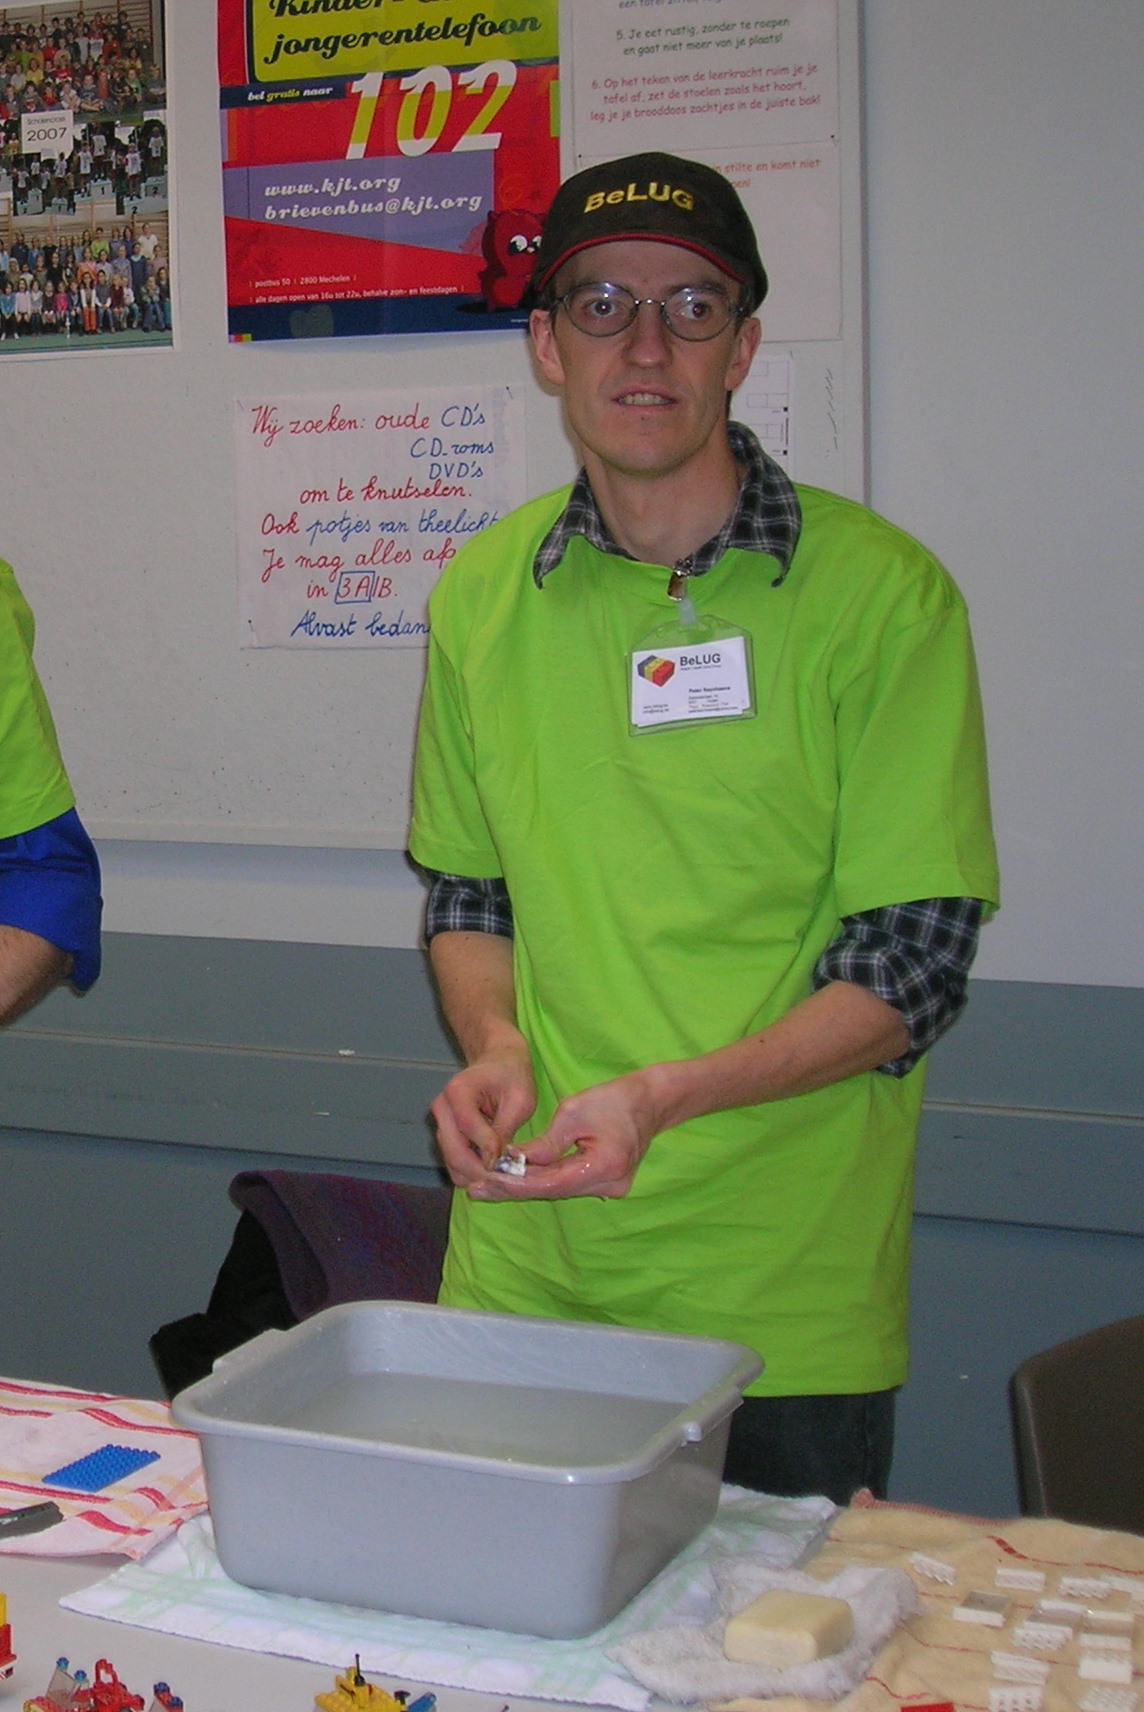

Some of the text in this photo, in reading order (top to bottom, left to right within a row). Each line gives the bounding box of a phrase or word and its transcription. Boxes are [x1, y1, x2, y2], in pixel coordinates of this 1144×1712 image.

[264, 13, 542, 64] jongerentelefoon
[629, 28, 642, 39] Je
[644, 28, 662, 38] eet
[702, 22, 737, 33] zonder
[740, 21, 751, 30] te
[754, 18, 790, 30] roepen
[623, 47, 635, 56] en
[637, 44, 661, 57] gaat
[663, 42, 683, 52] niet
[686, 40, 712, 50] meer
[715, 39, 732, 48] van
[735, 38, 746, 49] je
[603, 78, 619, 90] Op
[621, 77, 638, 87] het
[642, 75, 670, 86] teken
[673, 74, 690, 83] van
[692, 71, 705, 82] de
[709, 67, 762, 80] leerkracht
[766, 66, 790, 76] ruim
[792, 65, 804, 77] je
[806, 63, 818, 76] je
[248, 87, 333, 103] bel gratis naar
[603, 92, 628, 104] tafel
[648, 91, 665, 101] zet
[668, 89, 680, 99] de
[683, 86, 721, 99] stoelen
[724, 84, 750, 96] zoals
[752, 83, 771, 93] het
[346, 59, 518, 160] 102
[590, 111, 605, 124] leg
[608, 110, 618, 123] je
[621, 110, 631, 122] je
[634, 106, 687, 118] brooddoos
[690, 102, 735, 114] zachtjes
[738, 102, 747, 110] in
[749, 99, 762, 109] de
[765, 98, 796, 111] juiste
[27, 127, 67, 142] 2007
[724, 163, 753, 173] stilte
[756, 163, 768, 171] en
[771, 160, 797, 170] komt
[800, 159, 821, 169] niet
[264, 176, 401, 198] www.kjt.org
[583, 182, 695, 213] BeLUG
[264, 194, 482, 220] brievenbus@kjt.org
[319, 274, 350, 283] Mechelen
[255, 295, 266, 303] alle
[267, 294, 288, 303] dagen
[288, 294, 306, 302] open
[419, 286, 458, 295] feestdagen
[252, 402, 486, 447] Wij zoeken: oude CD's
[429, 461, 484, 480] DVD's
[299, 475, 472, 504] om te knutselen.
[261, 512, 300, 535] Ook
[306, 509, 372, 546] potjes
[378, 520, 409, 534] van
[261, 548, 285, 582] Je
[295, 555, 345, 582] mag
[355, 538, 412, 567] alles
[307, 582, 329, 598] in
[290, 609, 432, 637] Alvast bedan
[679, 653, 721, 667] BeLUG
